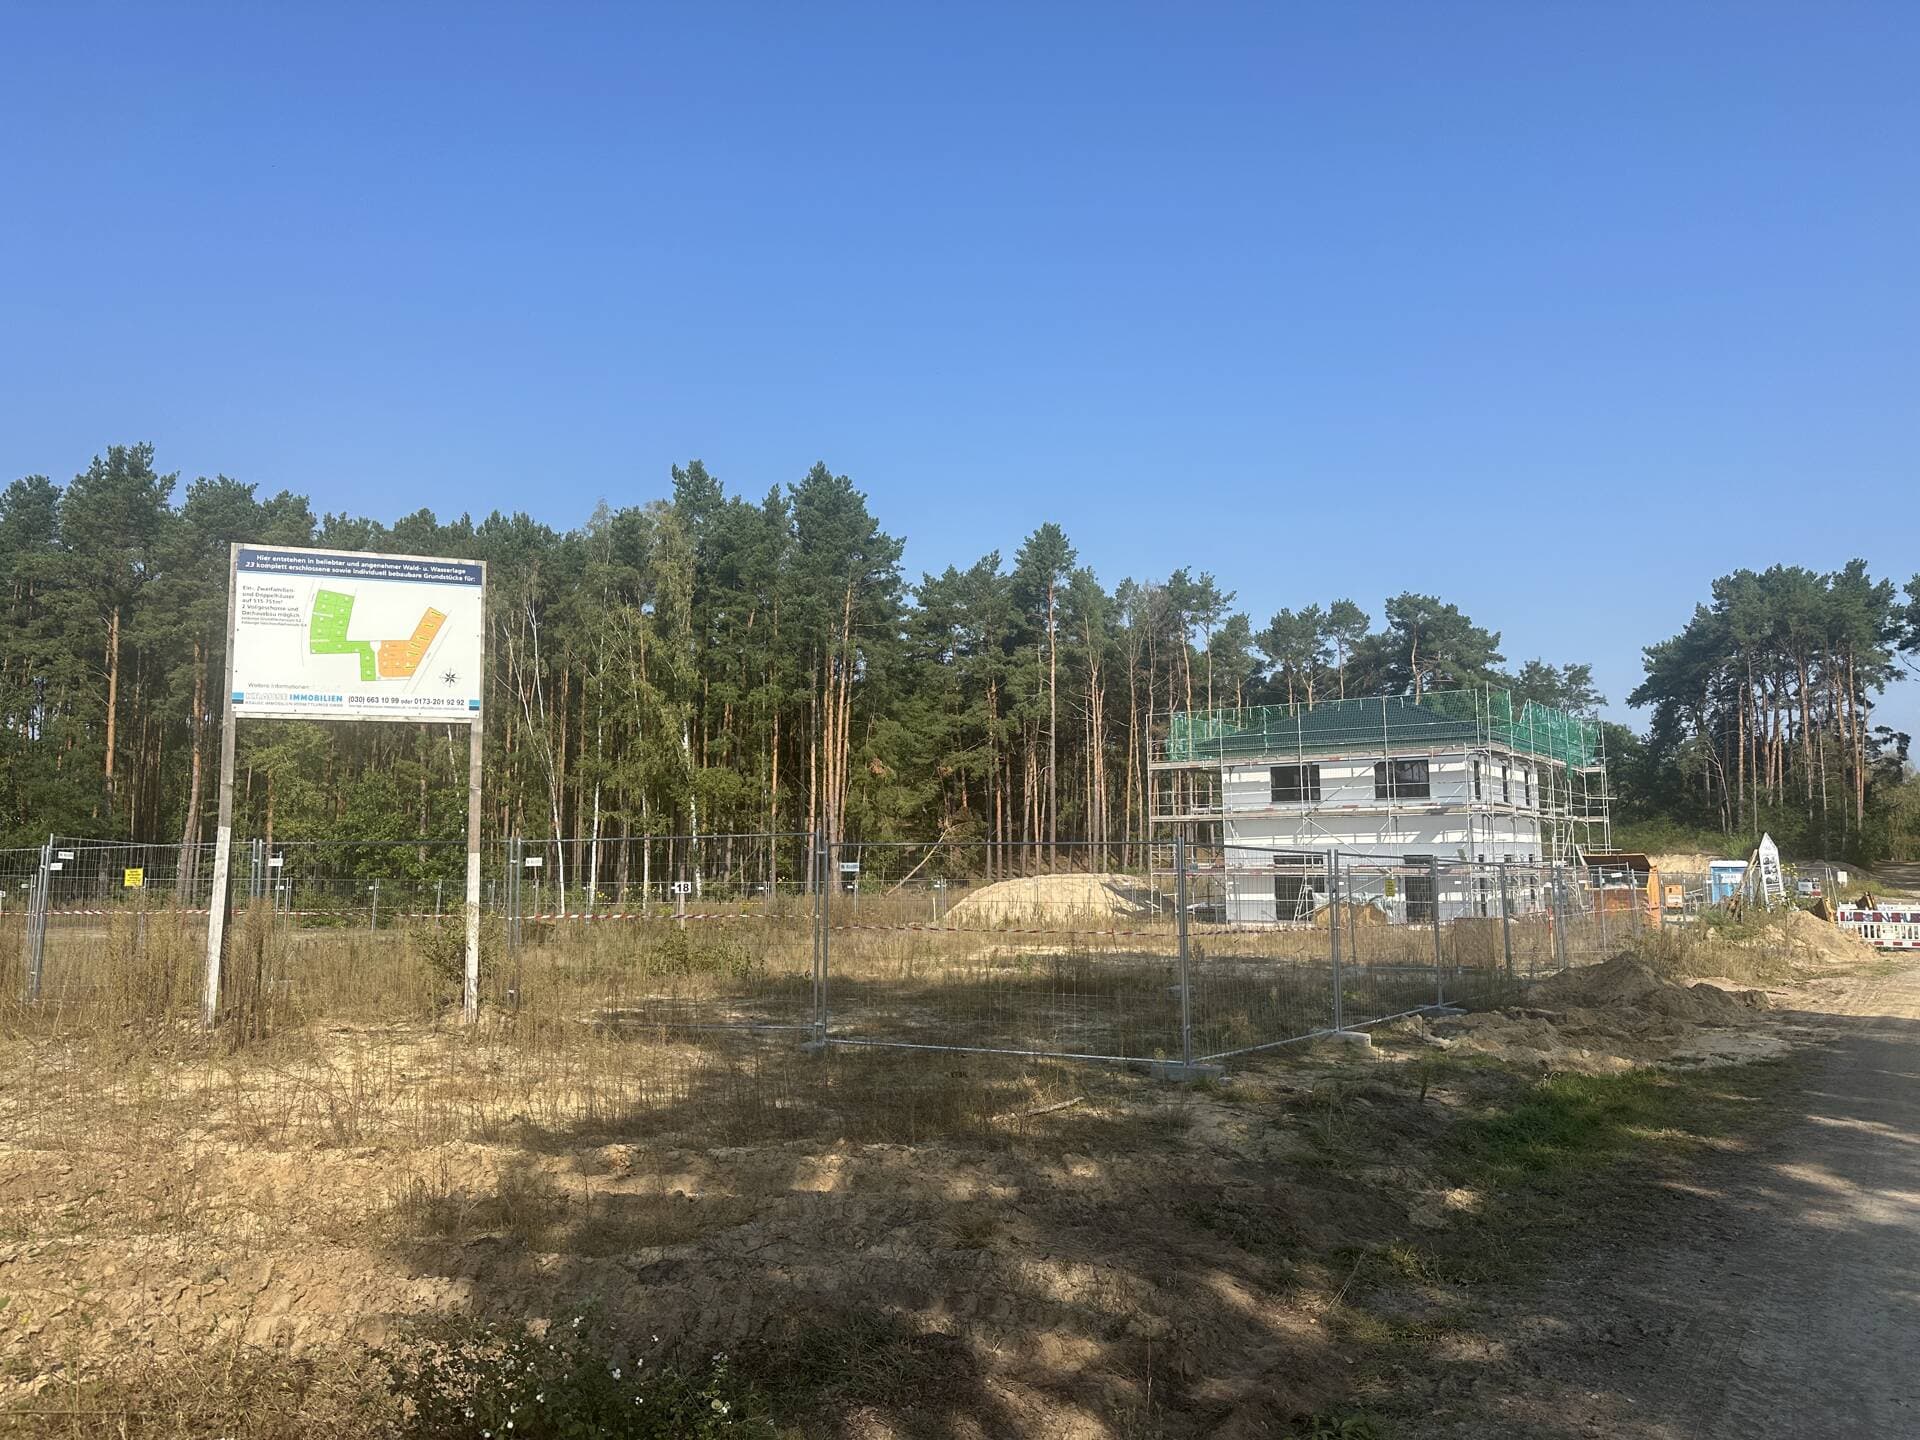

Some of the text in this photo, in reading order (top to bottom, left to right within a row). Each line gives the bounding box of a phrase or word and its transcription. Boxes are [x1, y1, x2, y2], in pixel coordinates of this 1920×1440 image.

[272, 556, 306, 564] entstehen
[315, 558, 346, 567] beliebter
[361, 562, 401, 570] angenehmer
[431, 566, 466, 575] Wasserlage
[256, 562, 288, 570] komplett
[288, 564, 331, 573] erschlossene
[388, 570, 422, 578] bebaubare
[423, 573, 463, 581] Grundstücke
[289, 693, 343, 703] IMMOBILIEN
[348, 696, 365, 704] (030)
[366, 696, 380, 704] 663
[677, 883, 689, 892] 18
